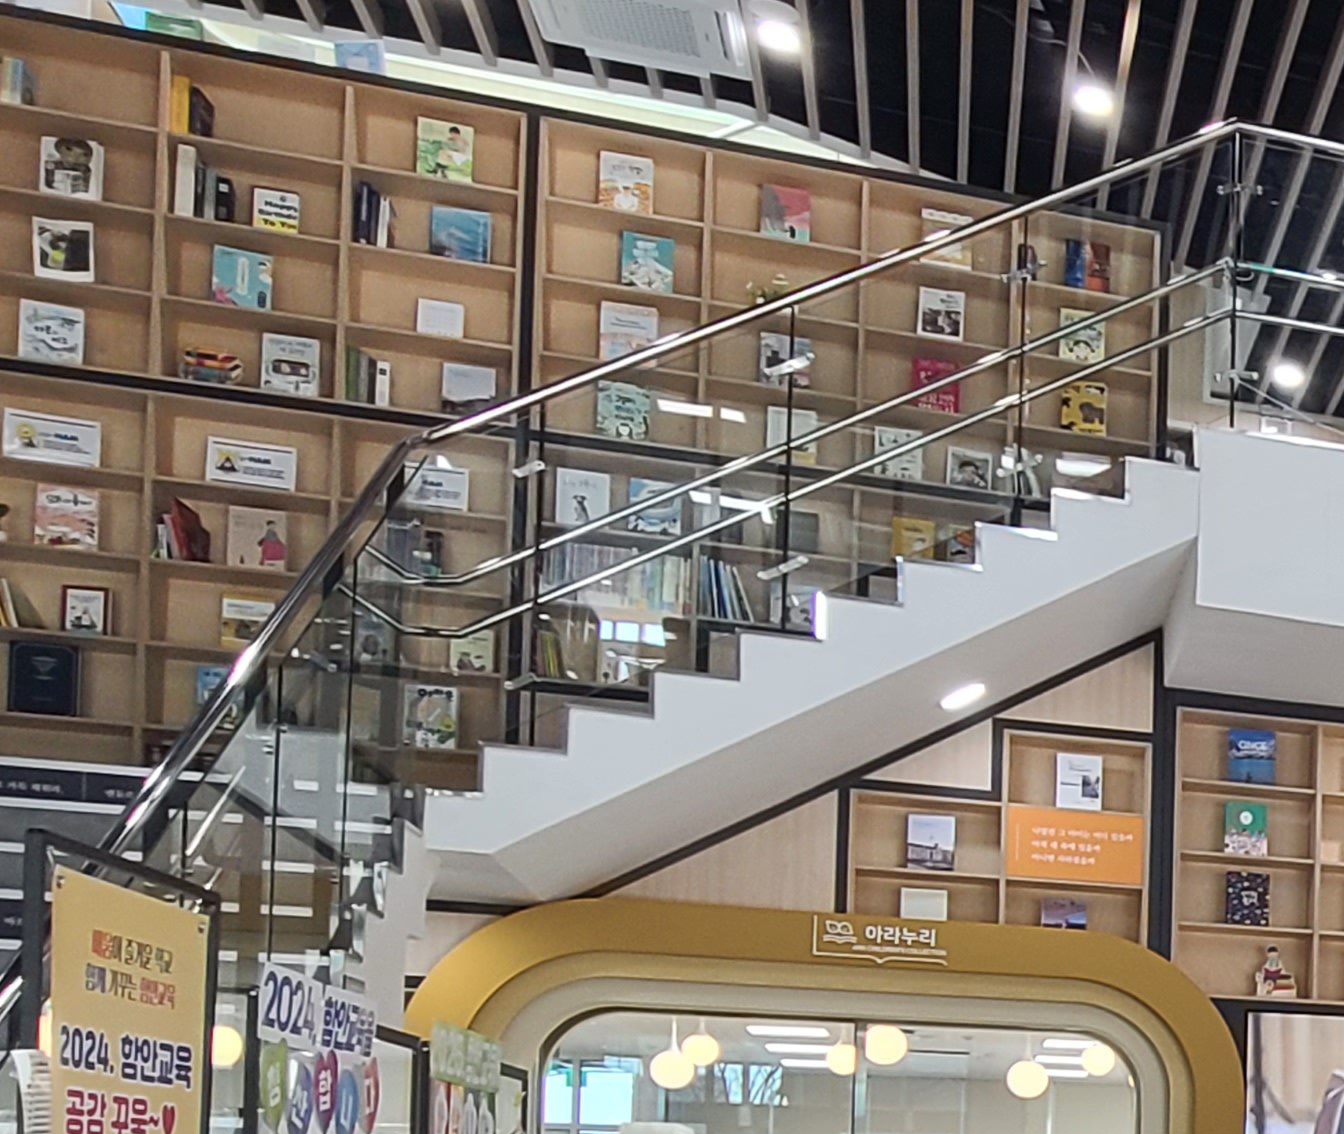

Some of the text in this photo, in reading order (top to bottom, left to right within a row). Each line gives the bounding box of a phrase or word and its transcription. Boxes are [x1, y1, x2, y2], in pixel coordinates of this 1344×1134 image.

[865, 925, 936, 947] 아라누리
[60, 1025, 193, 1090] 2024. 함안교육
